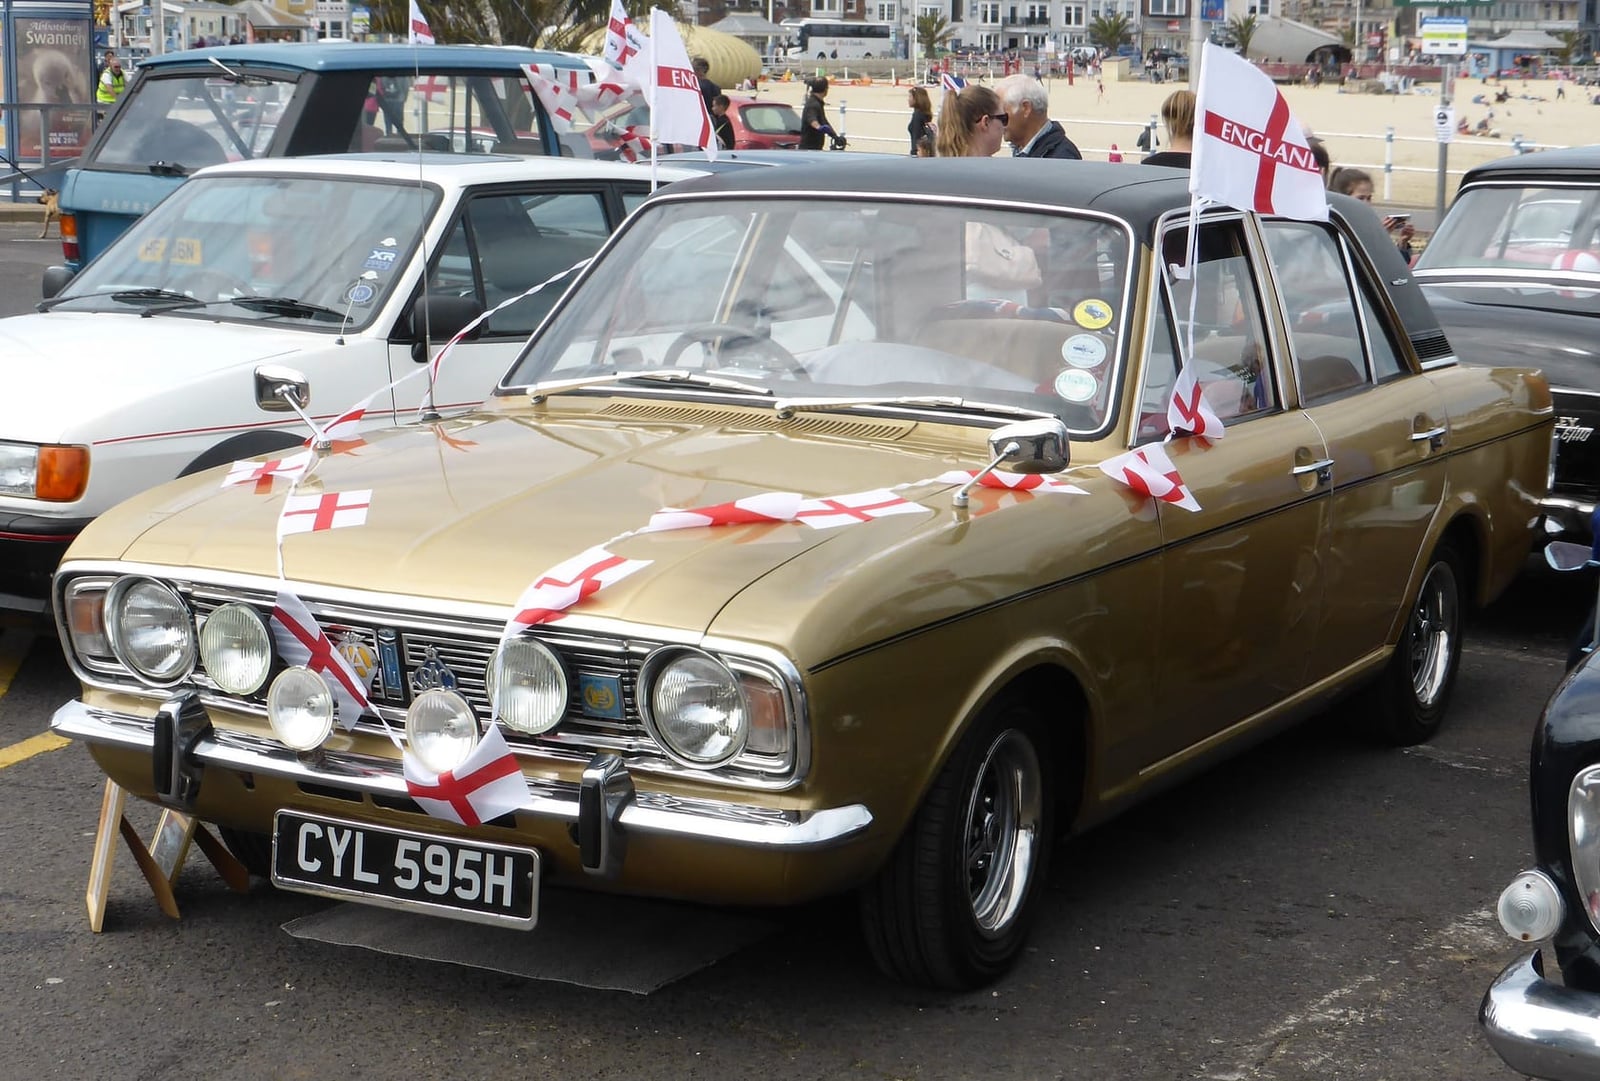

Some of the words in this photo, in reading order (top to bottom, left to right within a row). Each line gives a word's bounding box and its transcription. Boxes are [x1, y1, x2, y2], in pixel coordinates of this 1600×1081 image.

[368, 250, 396, 261] XR
[297, 822, 380, 885] CYL
[394, 838, 513, 907] 595H
